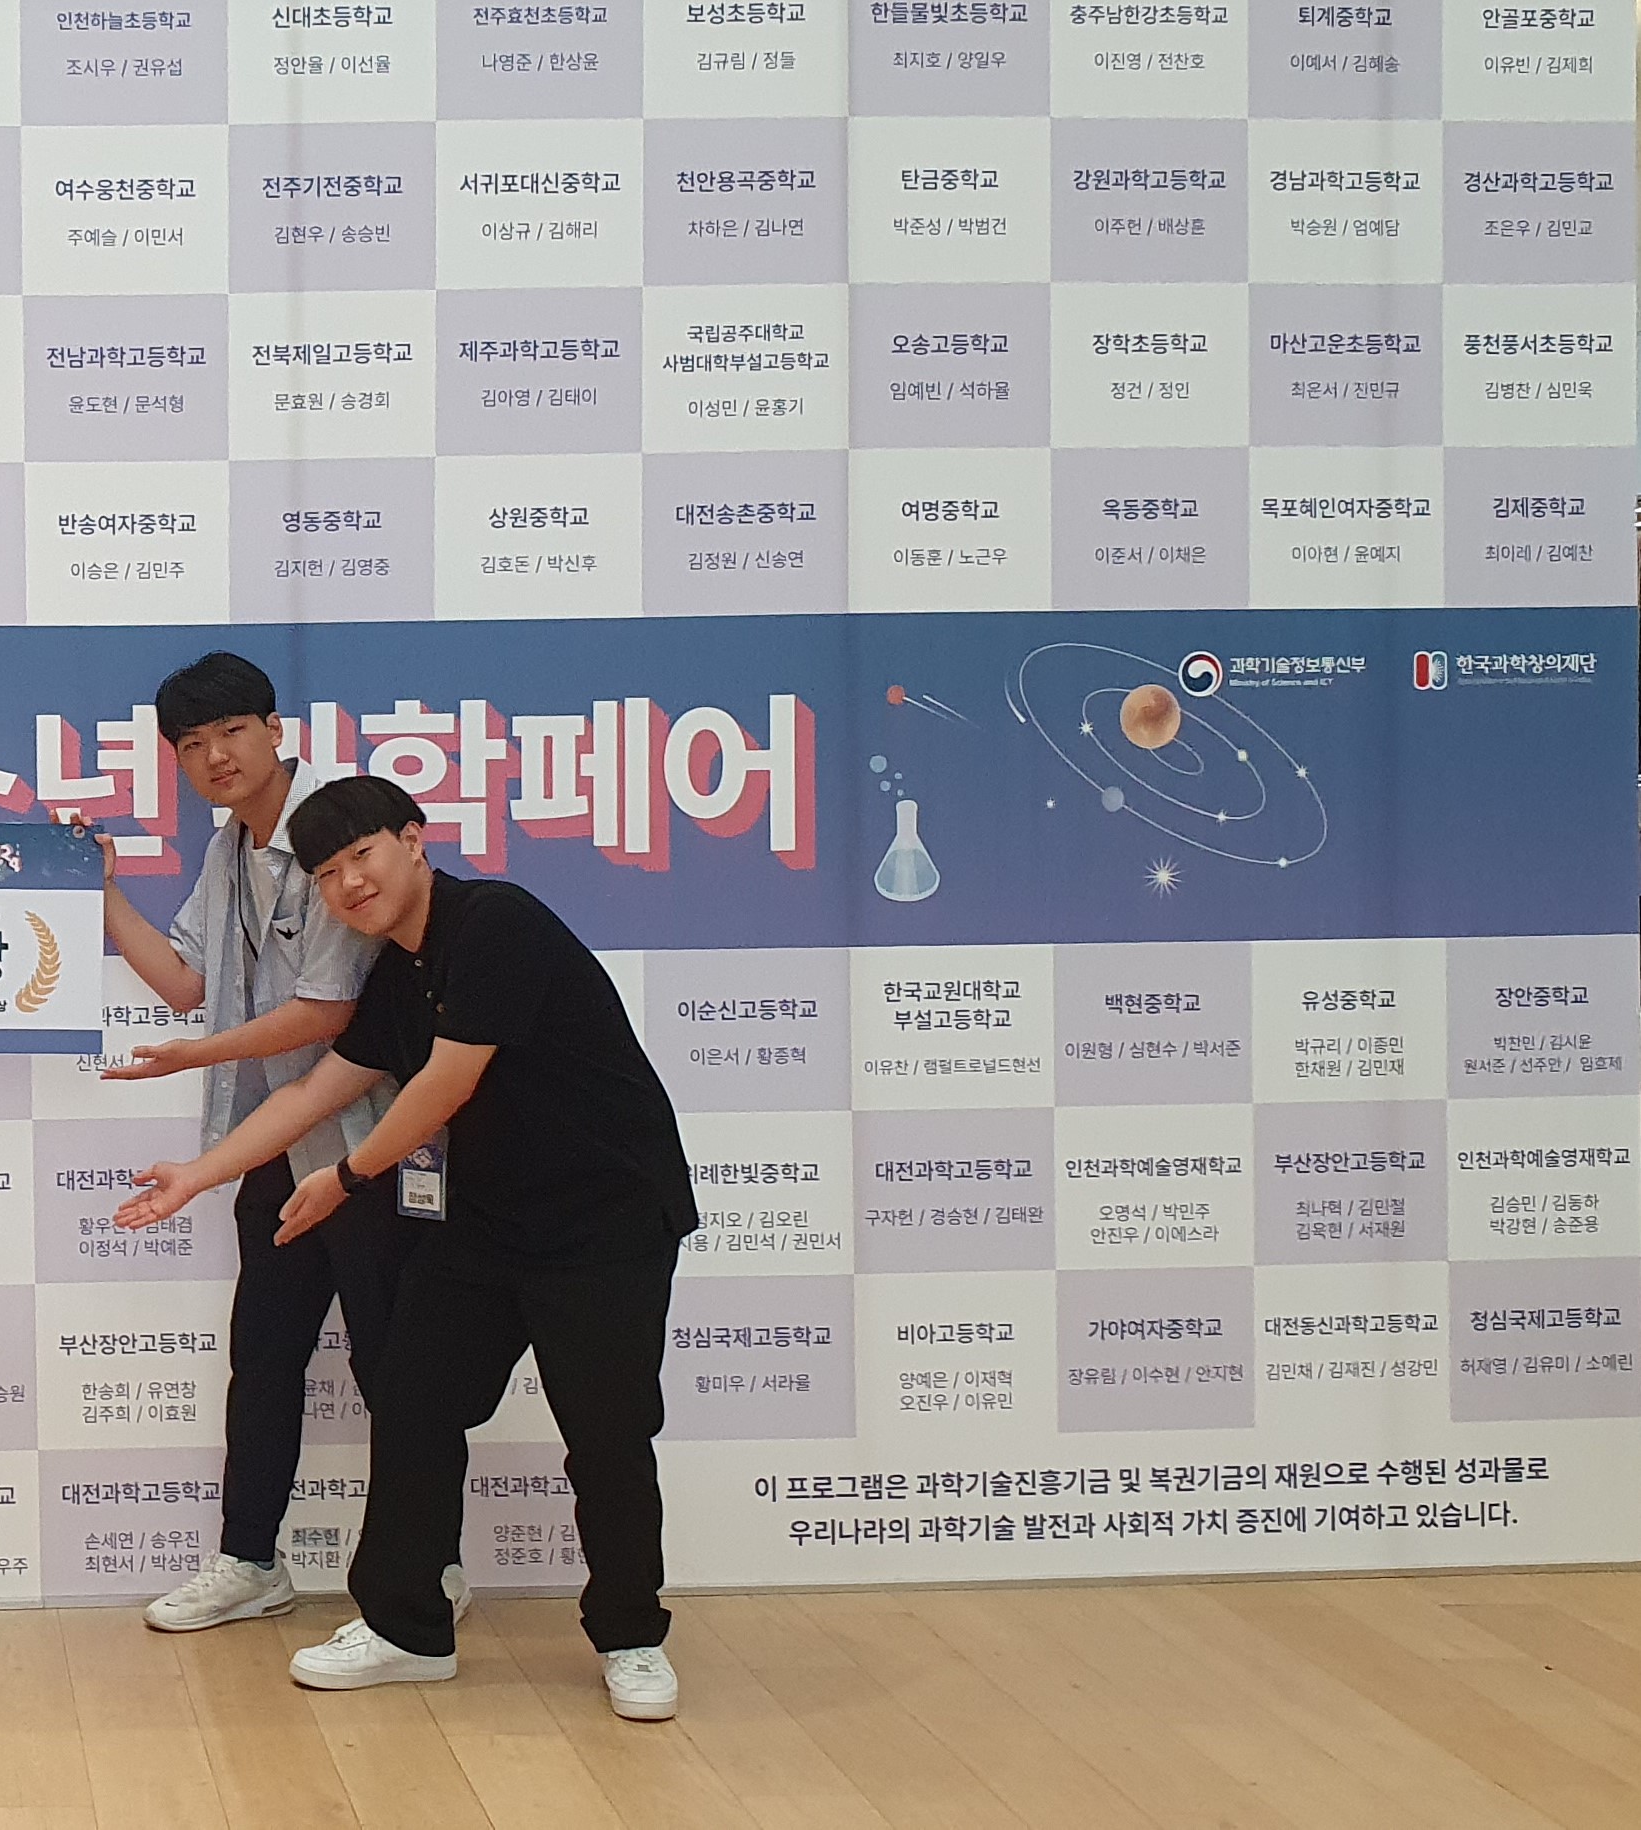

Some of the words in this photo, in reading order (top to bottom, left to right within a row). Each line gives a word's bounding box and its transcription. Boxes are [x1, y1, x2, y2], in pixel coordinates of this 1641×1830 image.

[56, 10, 192, 31] 인천하늘초등학교
[271, 4, 394, 29] 신대초등학교
[472, 5, 608, 27] 전주효천초등학교
[685, 1, 807, 26] 보성초등학교
[1069, 4, 1229, 26] 충주남한강초등학교
[1298, 5, 1393, 29] 퇴계중학교
[1482, 7, 1596, 30] 안골포중학교
[54, 177, 197, 202] 여수웅천중학교
[261, 174, 404, 200] 전주기전중학교
[459, 171, 622, 196] 서귀포대신중학교
[676, 168, 817, 193] 천안용곡중학교
[901, 167, 1000, 191] 탄금중학교
[1072, 168, 1227, 192] 강원과학고등학교
[1269, 169, 1421, 193] 경남과학고등학교
[1463, 170, 1615, 194] 경산과학고등학교
[481, 221, 531, 241] 이상규
[536, 222, 544, 242] /
[548, 220, 598, 241] 김해리
[686, 322, 805, 344] 국립공주대학교
[1092, 332, 1209, 356] 장학초등학교
[1463, 332, 1614, 356] 풍천풍서초등학교
[46, 345, 207, 369] 전남과학고등학교
[251, 341, 414, 367] 전북제일고등학교
[458, 337, 621, 363] 제주과학고등학교
[662, 351, 830, 374] 사범대학부설고등학교
[481, 388, 531, 408] 김아영
[535, 389, 544, 408] /
[548, 387, 597, 407] 김태이
[1110, 381, 1142, 400] 정건
[1147, 381, 1154, 399] /
[1158, 381, 1190, 400] 정인
[68, 395, 118, 415] 윤도현
[122, 396, 131, 415] /
[135, 394, 184, 414] 문석형
[688, 398, 737, 419] 이성민
[742, 399, 750, 418] /
[754, 397, 804, 417] 윤홍기
[488, 505, 590, 530] 상원중학교
[675, 501, 817, 527] 대전송촌중학교
[901, 498, 1001, 522] 여명중학교
[1492, 496, 1586, 519] 김제중학교
[58, 512, 197, 536] 반송여자중학교
[281, 509, 383, 534] 영동중학교
[688, 551, 737, 571] 김정원
[742, 552, 750, 571] /
[754, 549, 804, 569] 신송연
[1229, 656, 1366, 675] 과학기술정보통신부
[1455, 652, 1598, 675] 한국과학창의재단
[883, 980, 1022, 1003] 한국교원대학교
[1104, 992, 1202, 1015] 백현중학교
[1301, 988, 1397, 1012] 유성중학교
[677, 997, 819, 1022] 이순신고등학교
[893, 1008, 1013, 1032] 부설고등학교
[874, 1158, 1033, 1183] 대전과학고등학교
[1273, 1150, 1427, 1175] 부산장안고등학교
[1469, 1306, 1622, 1332] 청심국제고등학교
[58, 1331, 218, 1357] 부산장안고등학교
[672, 1325, 832, 1349] 청심국제고등학교
[896, 1321, 1016, 1346] 비아고등학교
[754, 1475, 777, 1503] 이
[785, 1473, 910, 1501] 프로그램은
[915, 1468, 1112, 1499] 과학기술진흥기금
[1118, 1466, 1142, 1494] 및
[1148, 1463, 1267, 1493] 복권기금의
[1274, 1461, 1370, 1490] 재원으로
[1376, 1458, 1447, 1487] 수행된
[1454, 1456, 1550, 1485] 성과물로
[61, 1480, 220, 1506] 대전과학고등학교
[788, 1516, 910, 1547] 우리나라의
[918, 1514, 1017, 1543] 과학기술
[1023, 1512, 1097, 1541] 발전과
[1102, 1510, 1174, 1539] 사회적
[1182, 1508, 1228, 1536] 가치
[1235, 1505, 1307, 1535] 증진에
[1314, 1503, 1410, 1532] 기여하고
[1415, 1500, 1518, 1529] 있습니다.
